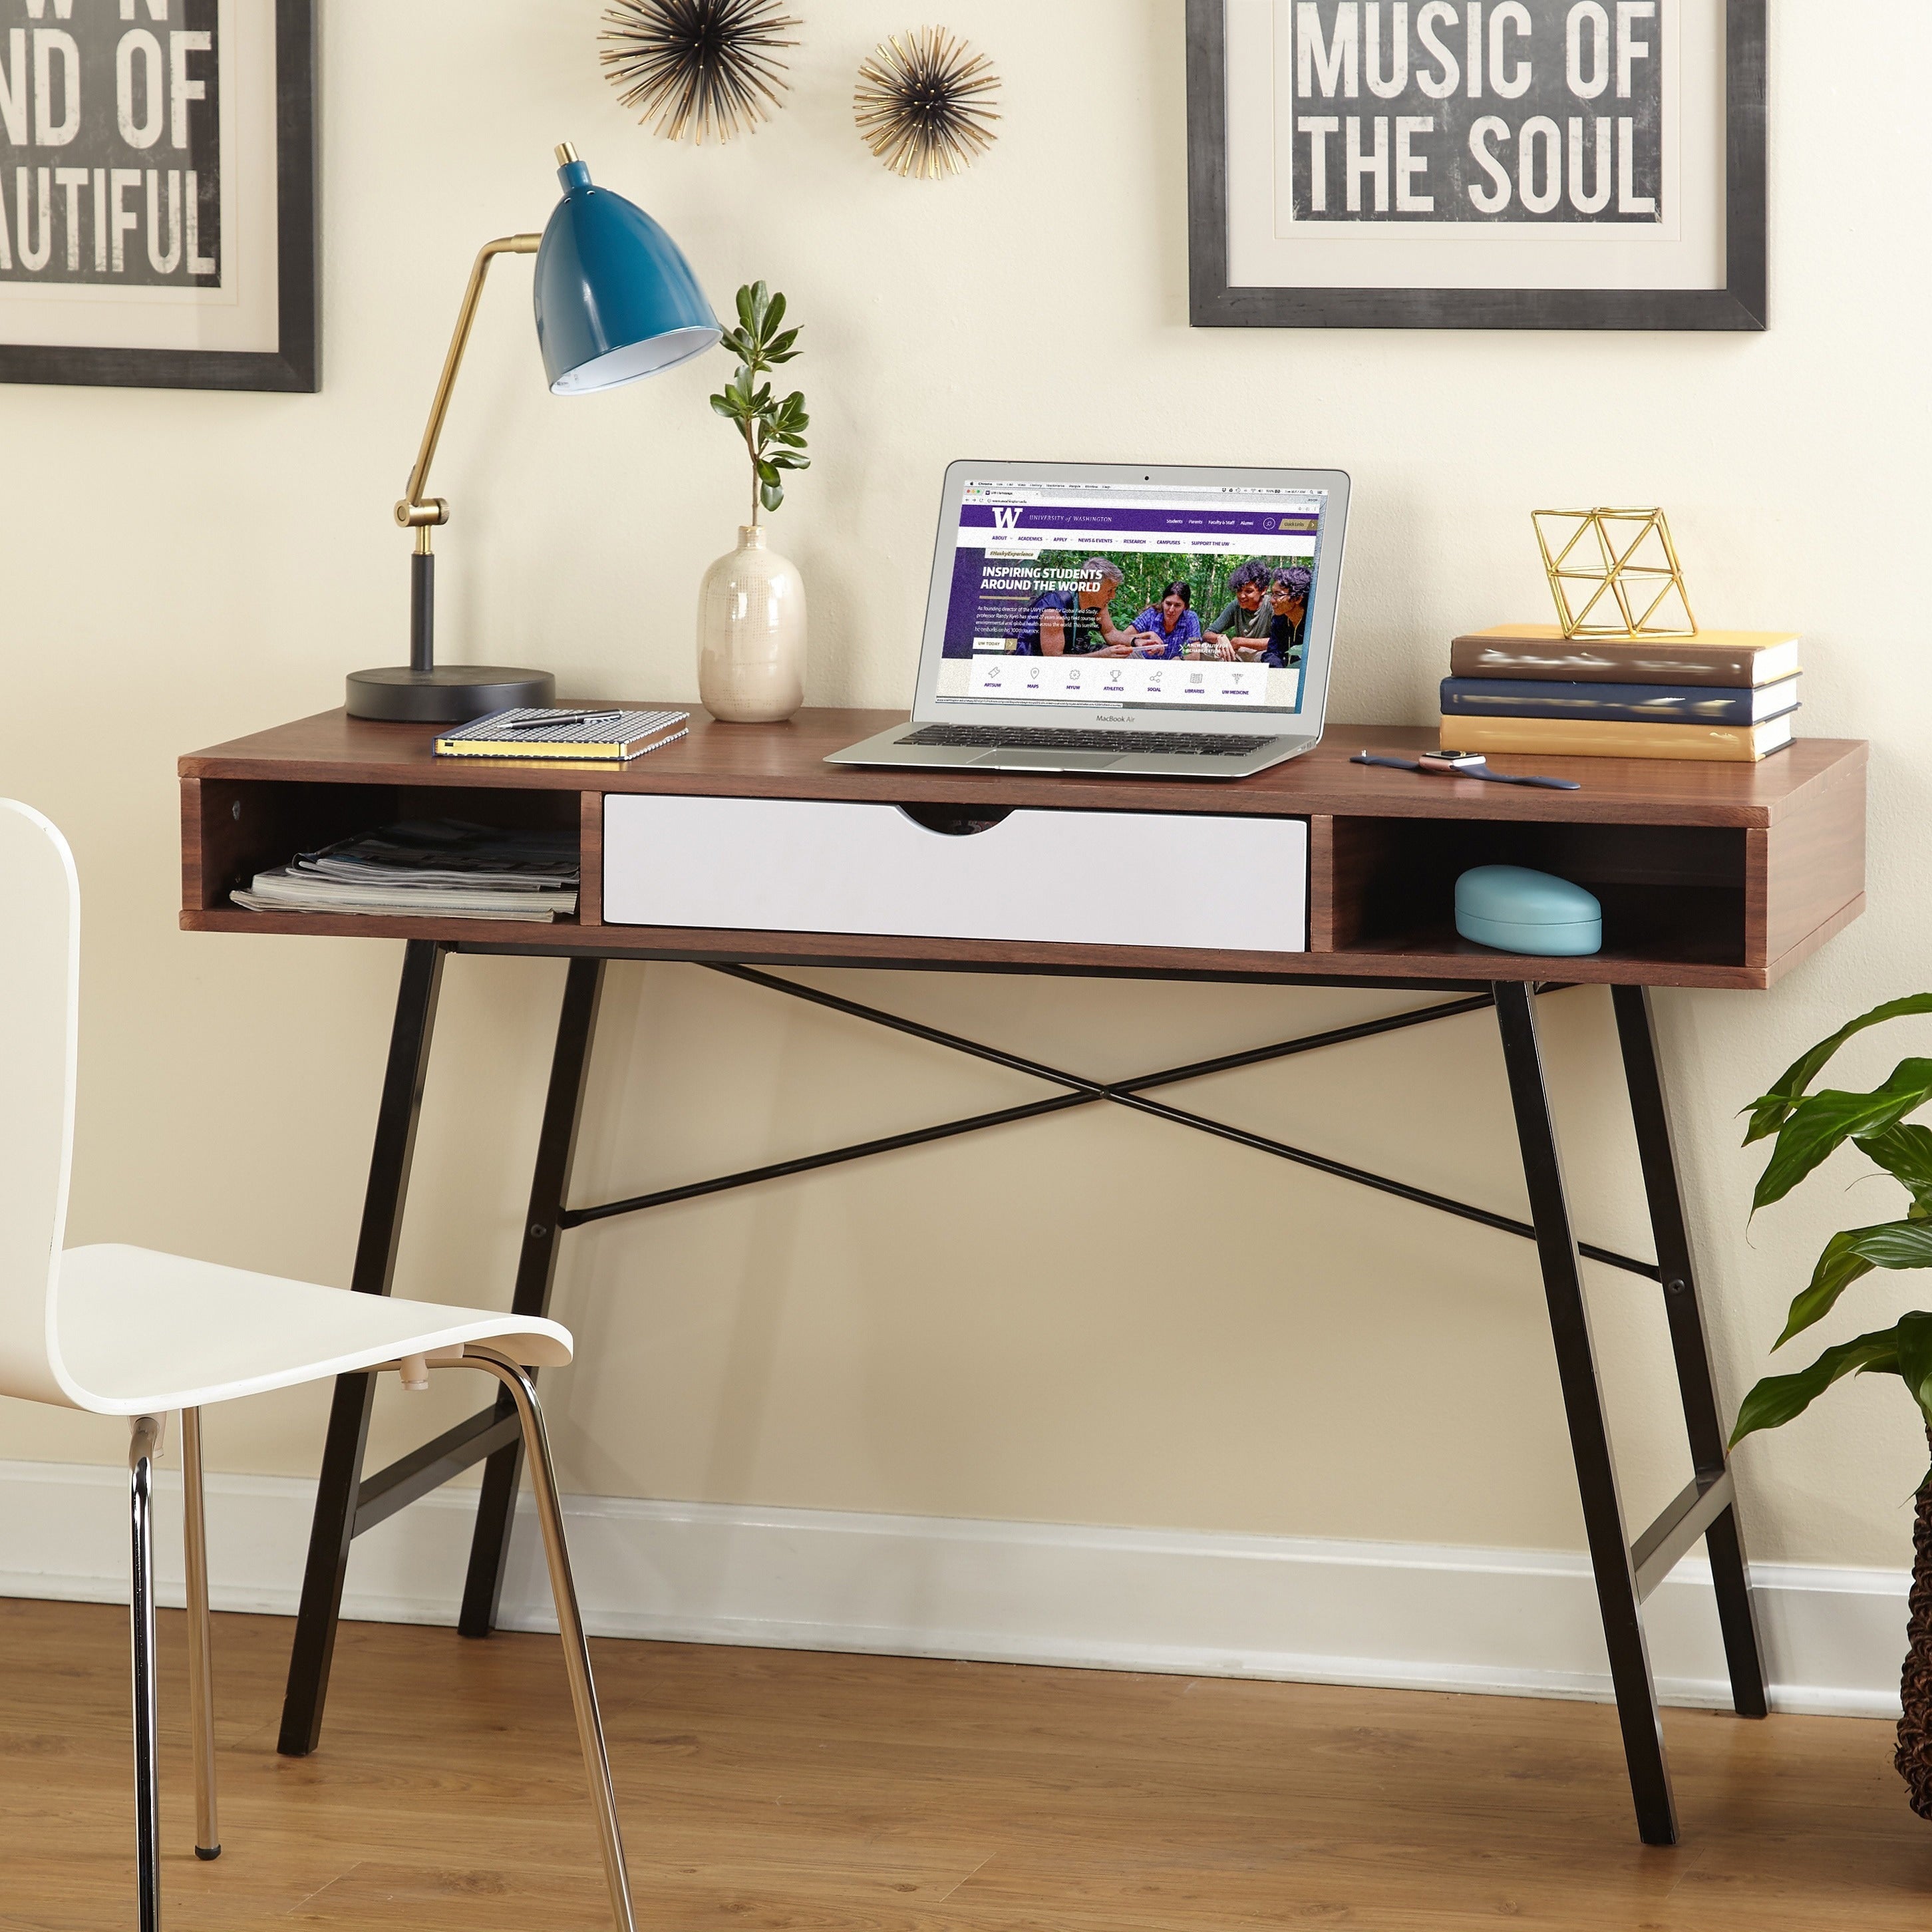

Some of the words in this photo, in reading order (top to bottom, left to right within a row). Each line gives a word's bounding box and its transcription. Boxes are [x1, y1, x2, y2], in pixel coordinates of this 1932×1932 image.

[1297, 0, 1532, 98] MUSIC
[1566, 1, 1655, 98] OF
[116, 29, 212, 148] OF
[1298, 116, 1434, 212] THE
[1468, 116, 1655, 214] SOUL
[992, 507, 1023, 528] W
[981, 579, 1031, 590] AROUND
[1031, 580, 1056, 591] THE
[1056, 581, 1101, 592] WORLD
[982, 566, 1041, 578] INSPIRING
[1041, 568, 1102, 579] STUDENTS
